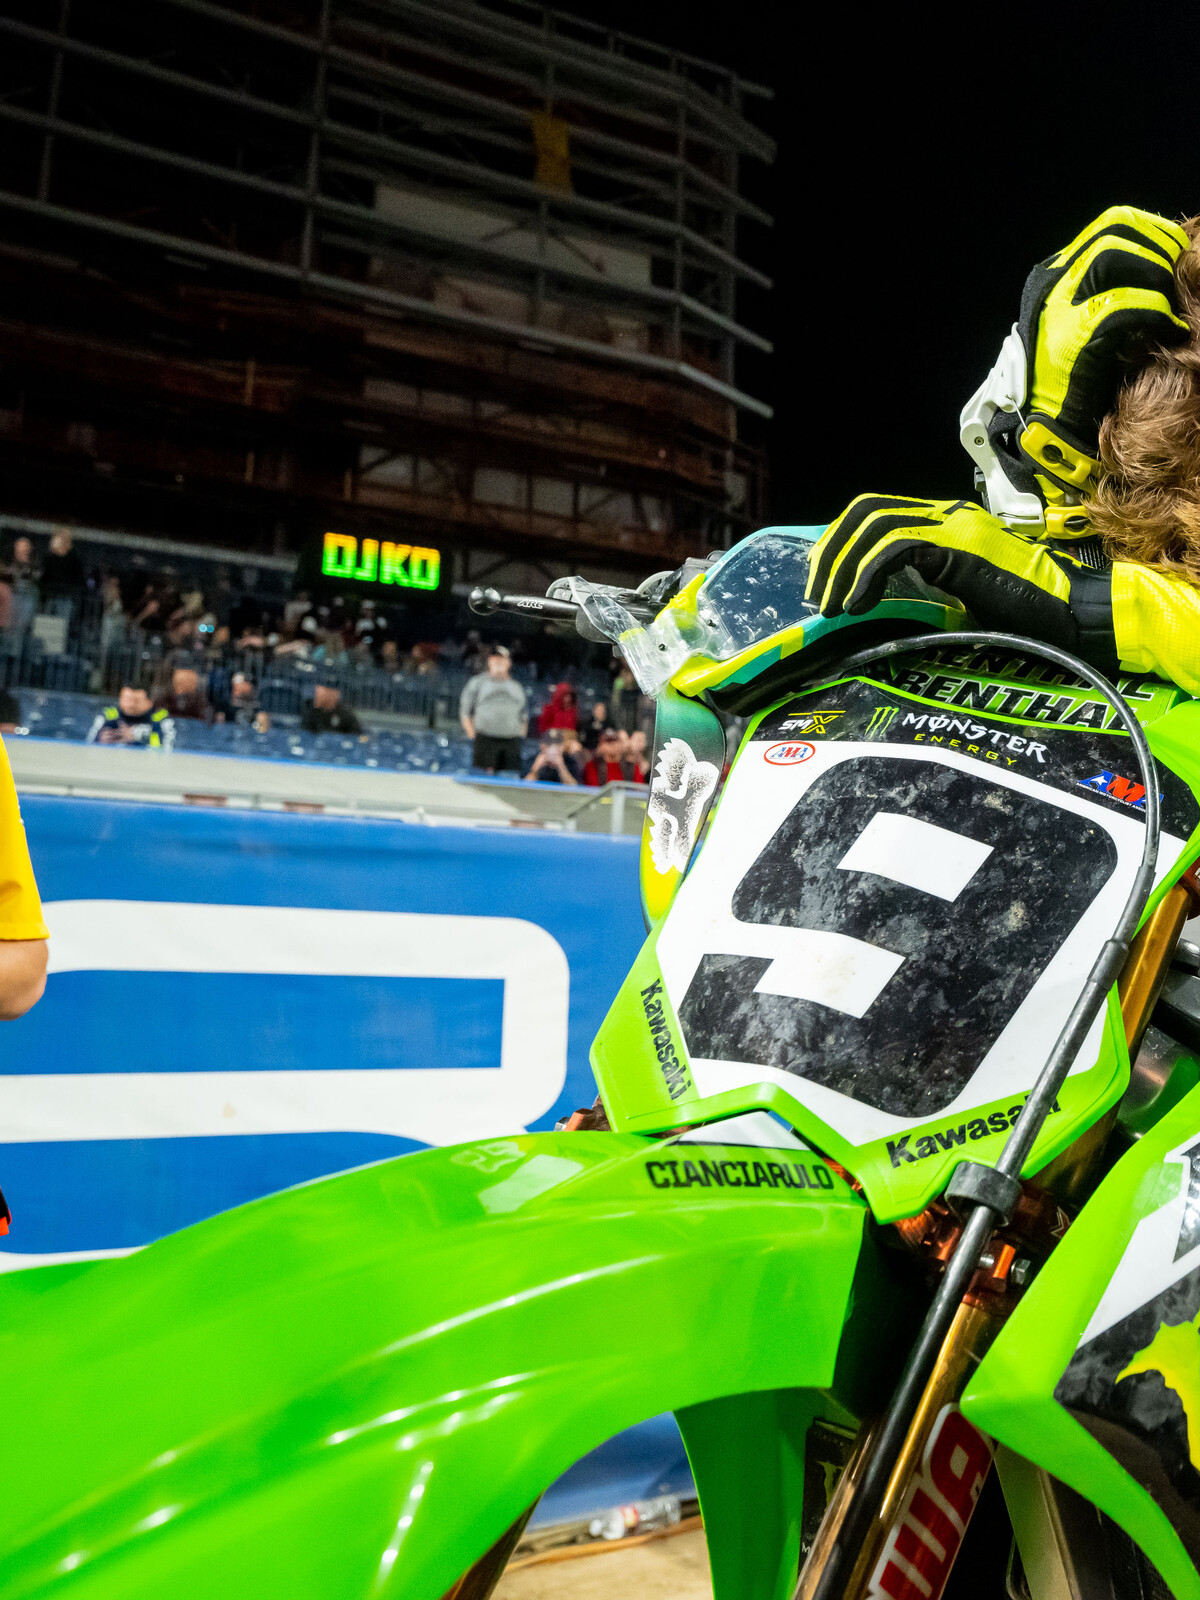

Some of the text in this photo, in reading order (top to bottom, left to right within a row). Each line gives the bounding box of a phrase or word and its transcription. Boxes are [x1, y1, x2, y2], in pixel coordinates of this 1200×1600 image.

[517, 599, 545, 610] ARC
[777, 712, 841, 734] SMX
[769, 746, 808, 759] AMA
[913, 733, 1017, 766] ENERGY
[678, 755, 1119, 1119] 9
[640, 978, 692, 1101] Kawasaki
[886, 1094, 1061, 1169] Kawasa
[645, 1160, 834, 1190] CIANCIARULO
